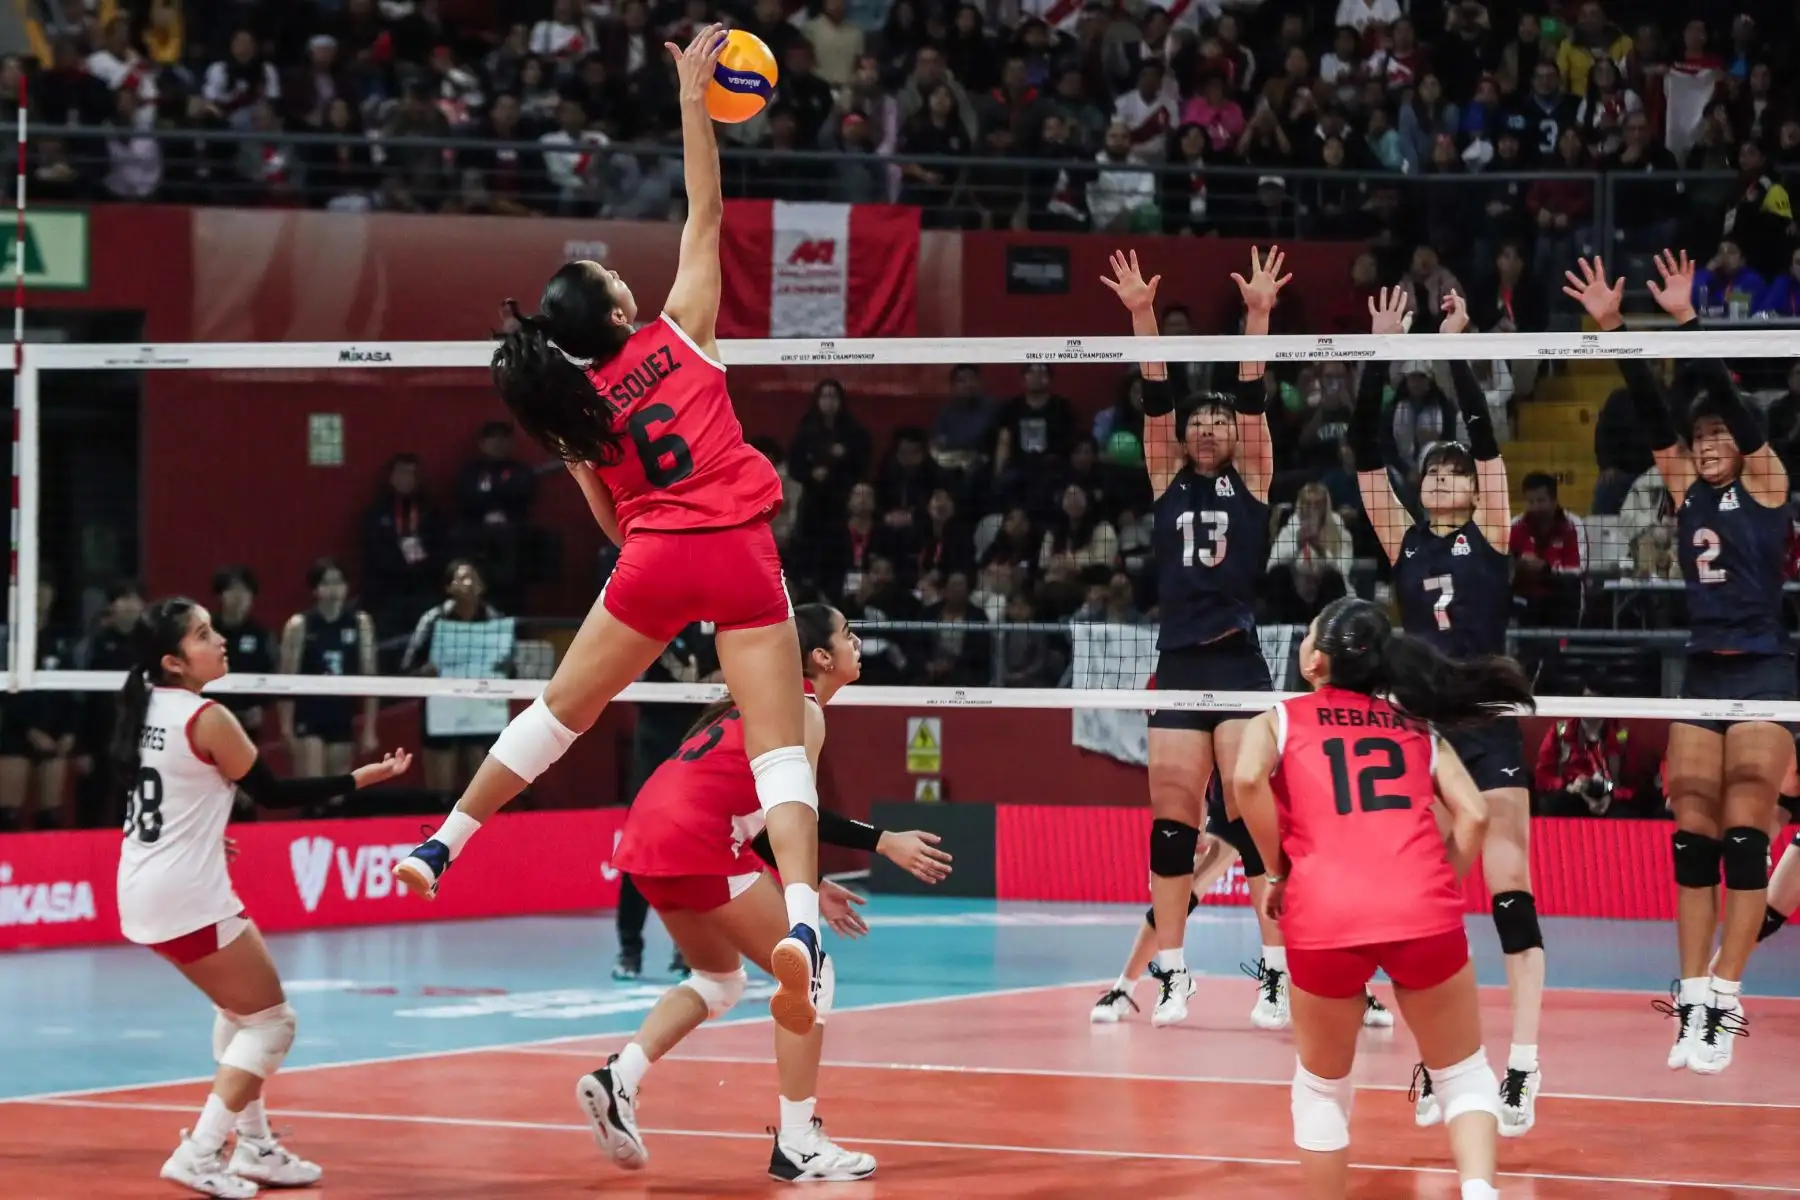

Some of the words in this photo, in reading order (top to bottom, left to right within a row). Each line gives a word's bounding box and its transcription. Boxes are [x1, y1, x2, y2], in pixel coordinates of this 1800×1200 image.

[603, 344, 682, 417] SQUEZ
[812, 353, 832, 361] WORLD
[628, 403, 694, 488] 6
[1176, 510, 1229, 568] 13
[1692, 527, 1727, 584] 2
[1422, 573, 1454, 630] 7
[1316, 707, 1408, 732] REBATA
[124, 766, 163, 843] 8
[1322, 737, 1412, 815] 12
[336, 842, 420, 900] VBT
